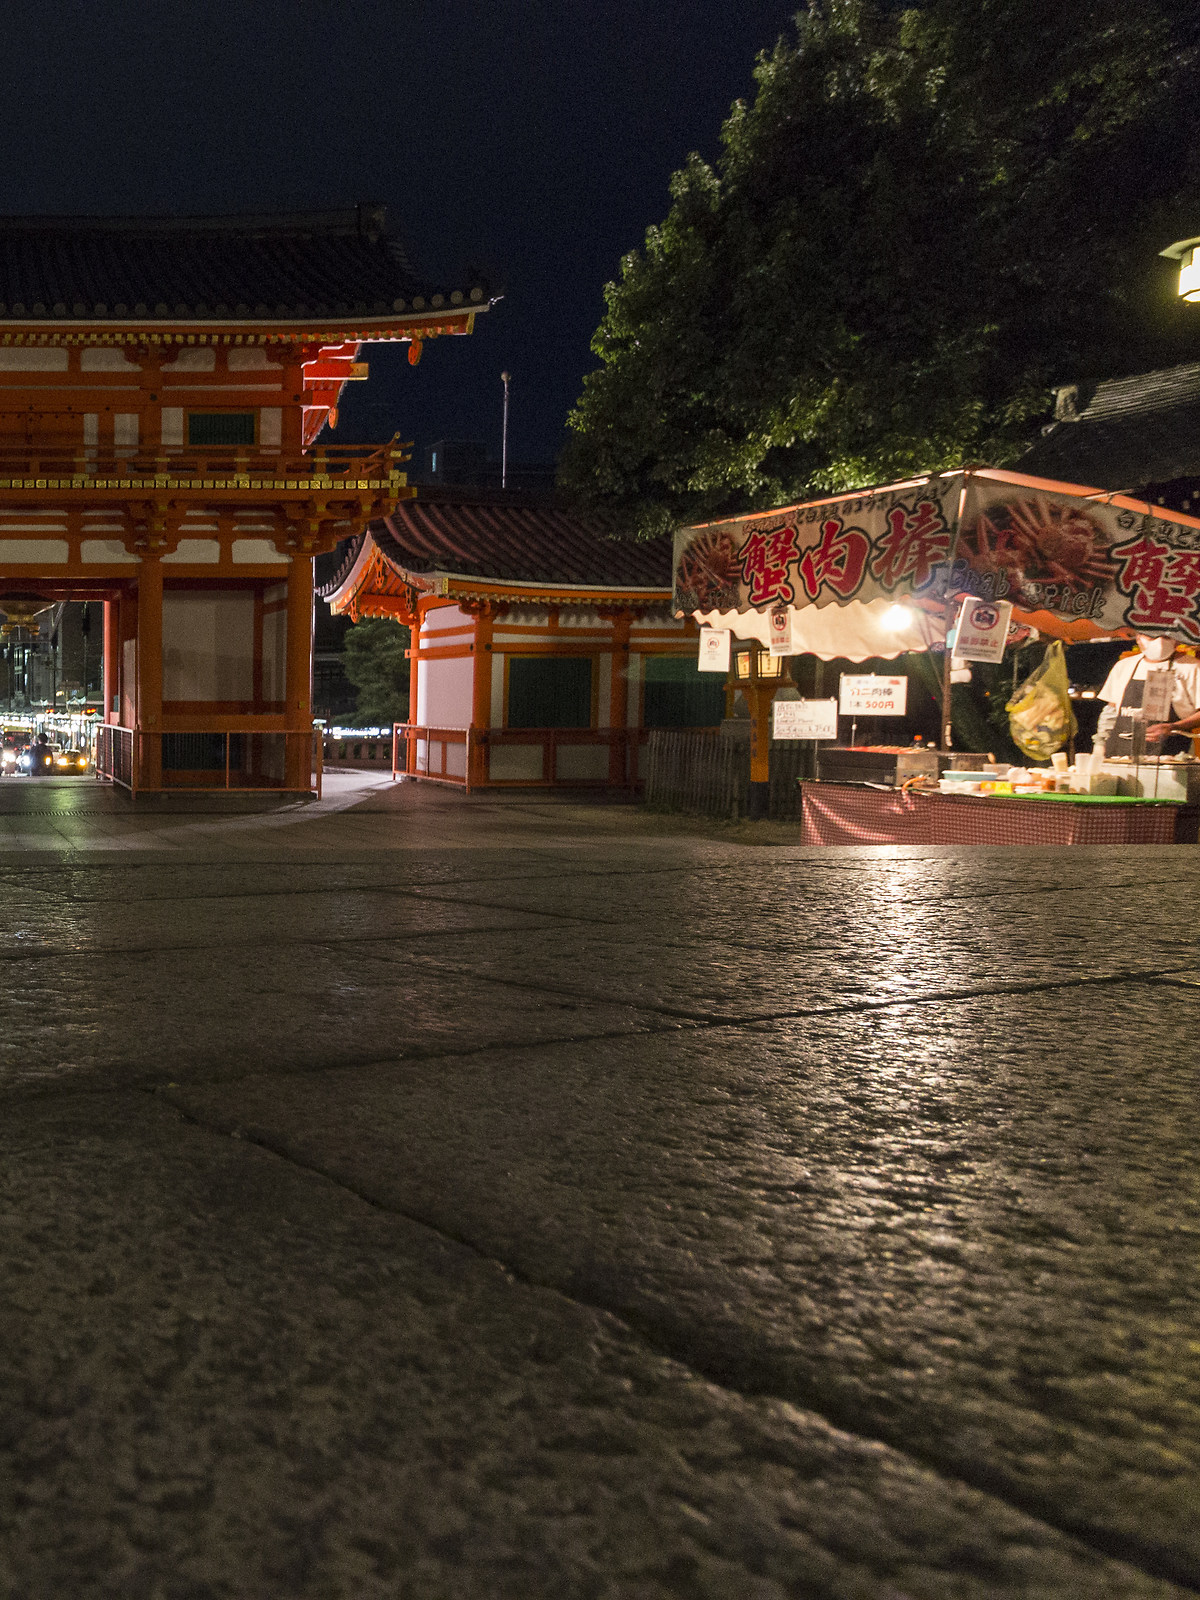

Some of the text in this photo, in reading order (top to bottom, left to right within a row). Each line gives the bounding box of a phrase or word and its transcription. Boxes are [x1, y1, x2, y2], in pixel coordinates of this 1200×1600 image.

[739, 501, 952, 606] 蟹肉棒
[947, 557, 1011, 598] Crab
[865, 700, 895, 709] 500円
